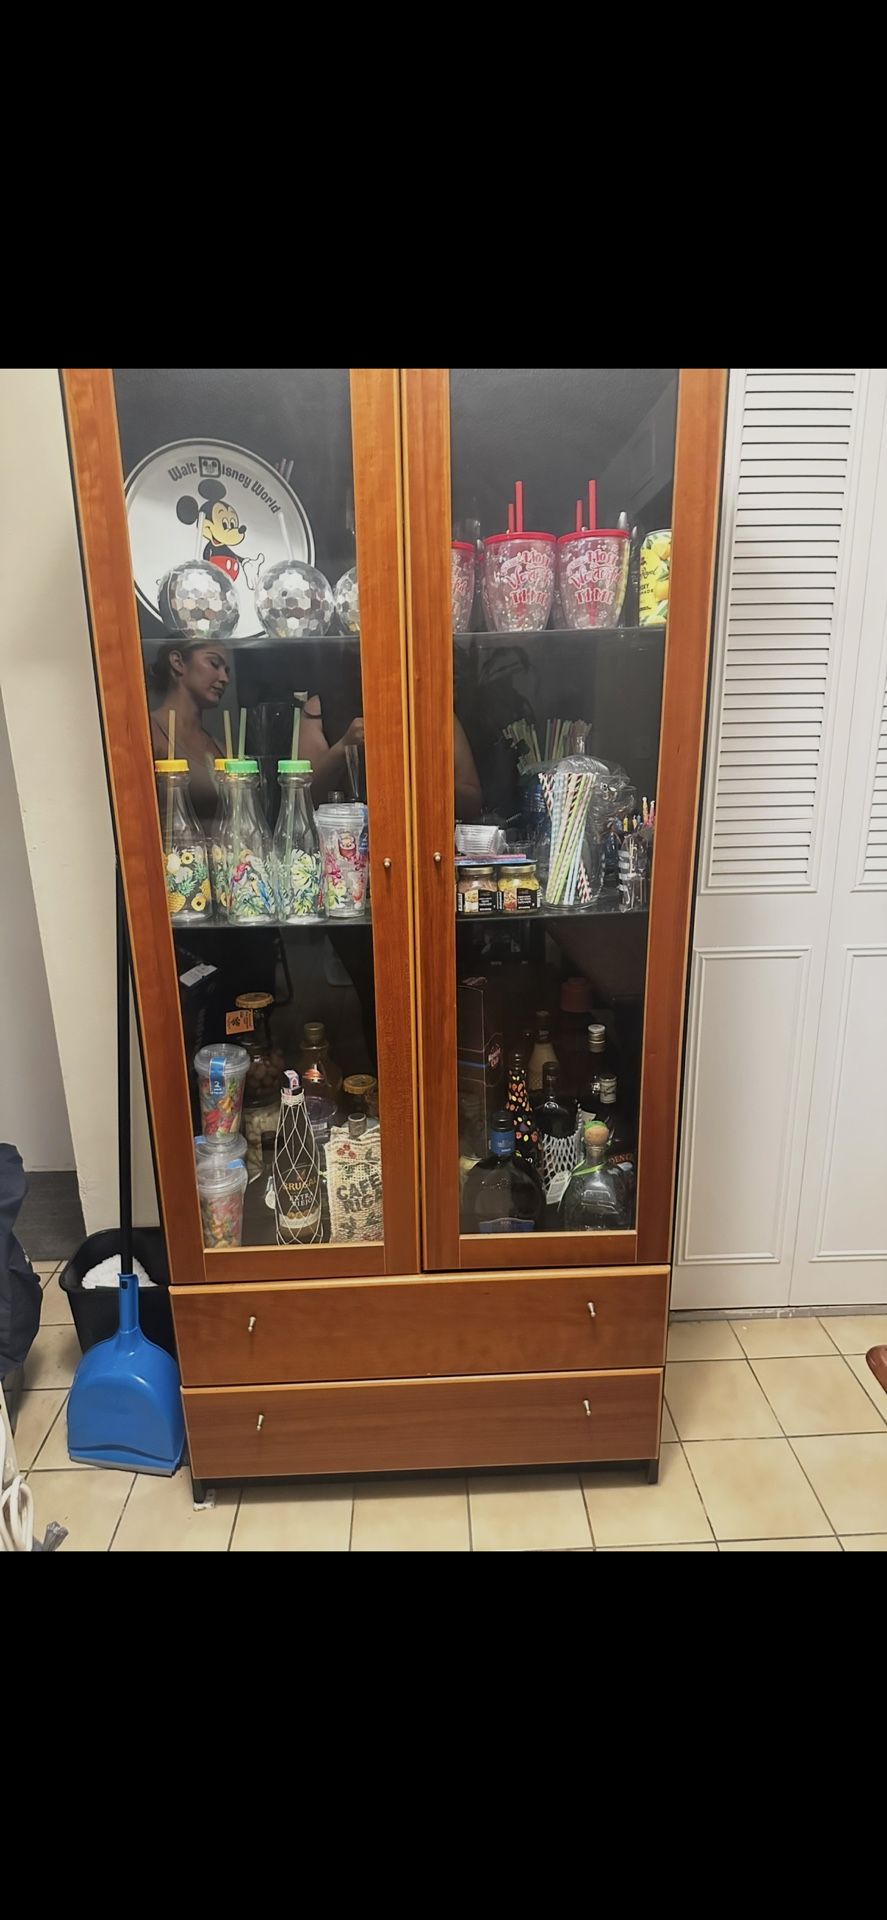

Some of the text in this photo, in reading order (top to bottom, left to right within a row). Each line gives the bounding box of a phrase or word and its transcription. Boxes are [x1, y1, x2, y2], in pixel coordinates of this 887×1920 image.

[168, 456, 281, 514] Walt Disney World
[214, 1080, 221, 1088] 2
[336, 1172, 382, 1200] CAFE
